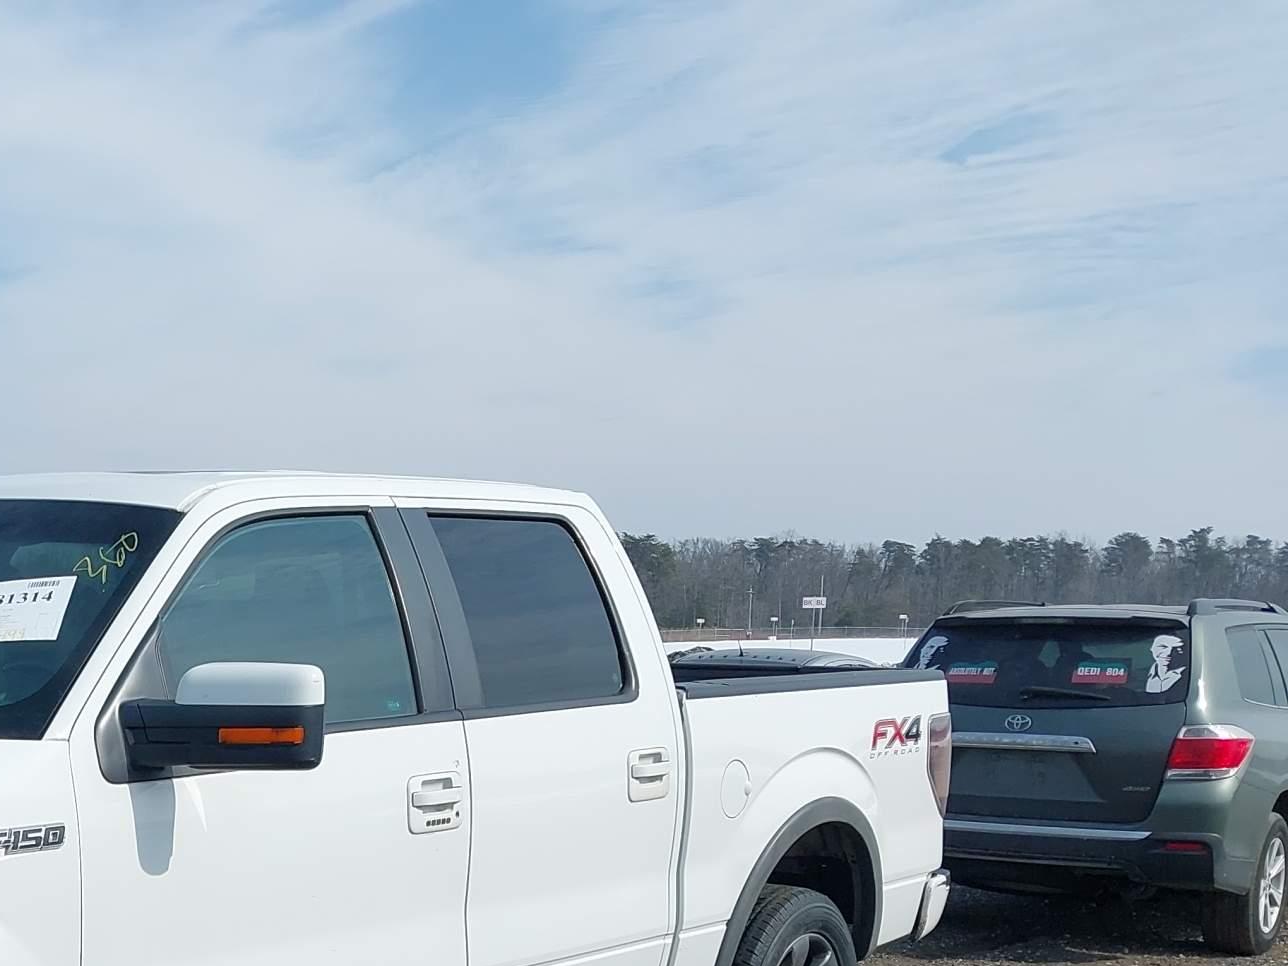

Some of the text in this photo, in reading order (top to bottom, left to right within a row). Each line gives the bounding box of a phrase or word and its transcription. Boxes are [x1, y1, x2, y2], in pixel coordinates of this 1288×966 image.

[1105, 667, 1125, 676] 804
[871, 715, 922, 751] FX4
[869, 747, 920, 760] OFF ROAD
